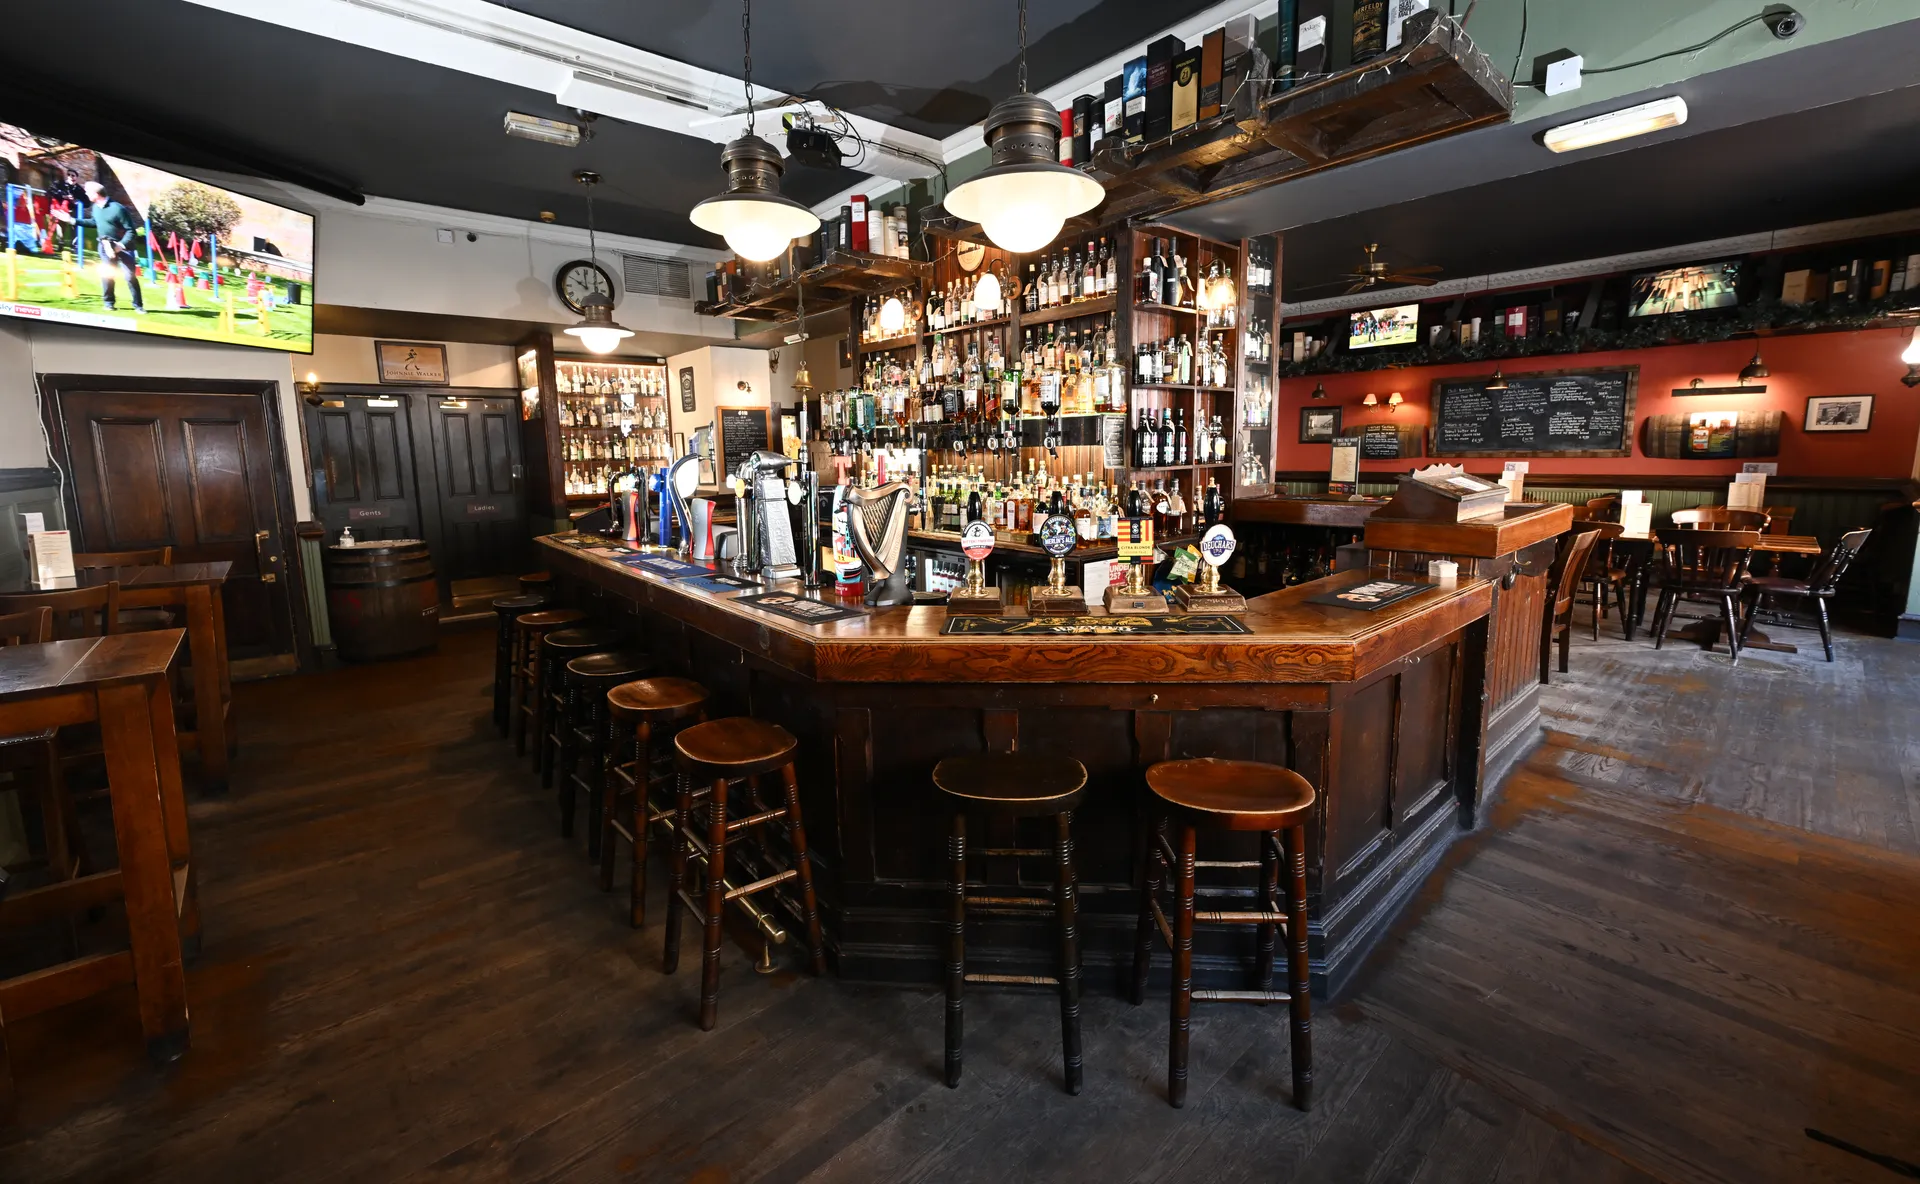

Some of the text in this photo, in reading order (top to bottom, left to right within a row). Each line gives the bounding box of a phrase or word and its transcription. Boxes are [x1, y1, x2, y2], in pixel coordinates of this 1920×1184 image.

[1182, 70, 1188, 79] 21
[15, 306, 40, 316] news
[1203, 540, 1235, 551] DEUCHARS
[1110, 572, 1120, 580] 25?
